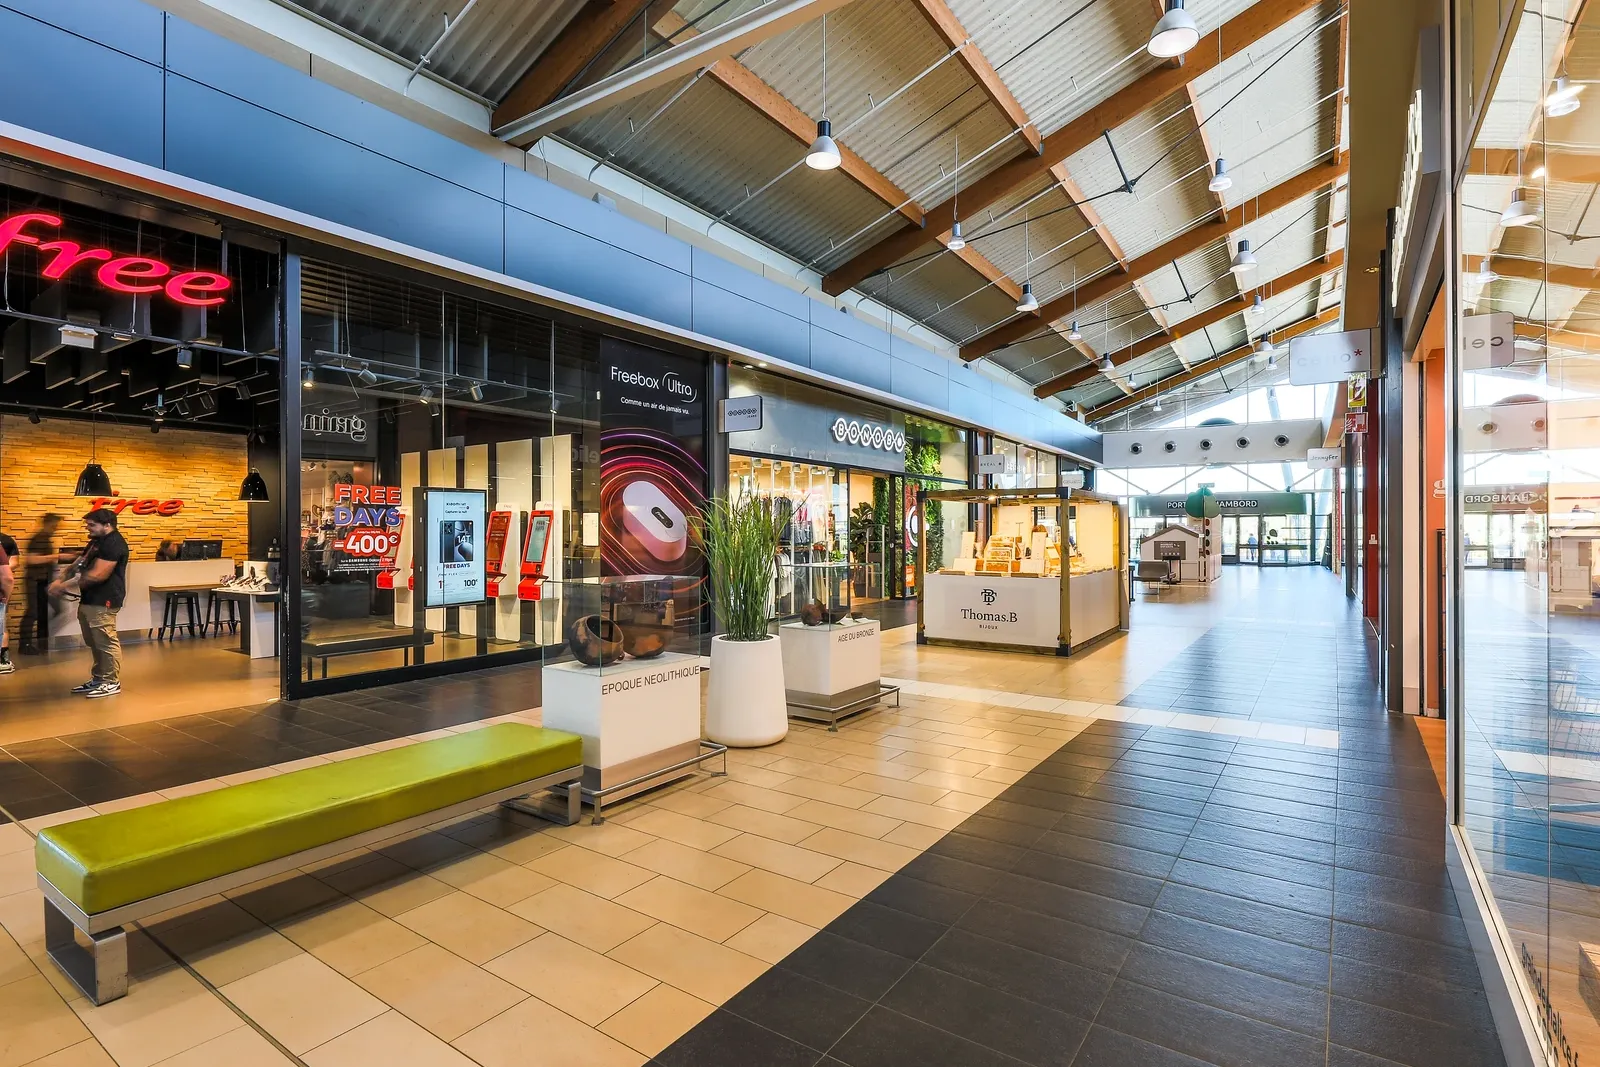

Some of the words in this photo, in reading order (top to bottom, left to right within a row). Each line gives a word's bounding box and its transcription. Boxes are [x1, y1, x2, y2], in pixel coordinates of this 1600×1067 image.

[0, 213, 232, 306] free
[611, 366, 660, 390] Freebox
[667, 378, 692, 396] Ultra
[620, 396, 642, 406] Comme
[658, 402, 666, 411] de
[665, 404, 682, 413] jamais
[833, 418, 906, 453] BONOBO
[334, 484, 402, 505] FREE
[1167, 501, 1186, 509] PORT
[1216, 500, 1258, 508] AMBORD
[334, 505, 401, 527] DAYS
[837, 633, 848, 643] AGE
[848, 632, 856, 641] DU
[856, 628, 875, 638] BRONZE
[601, 677, 642, 695] EPOQUE
[644, 665, 700, 686] NEOLITHIQUE
